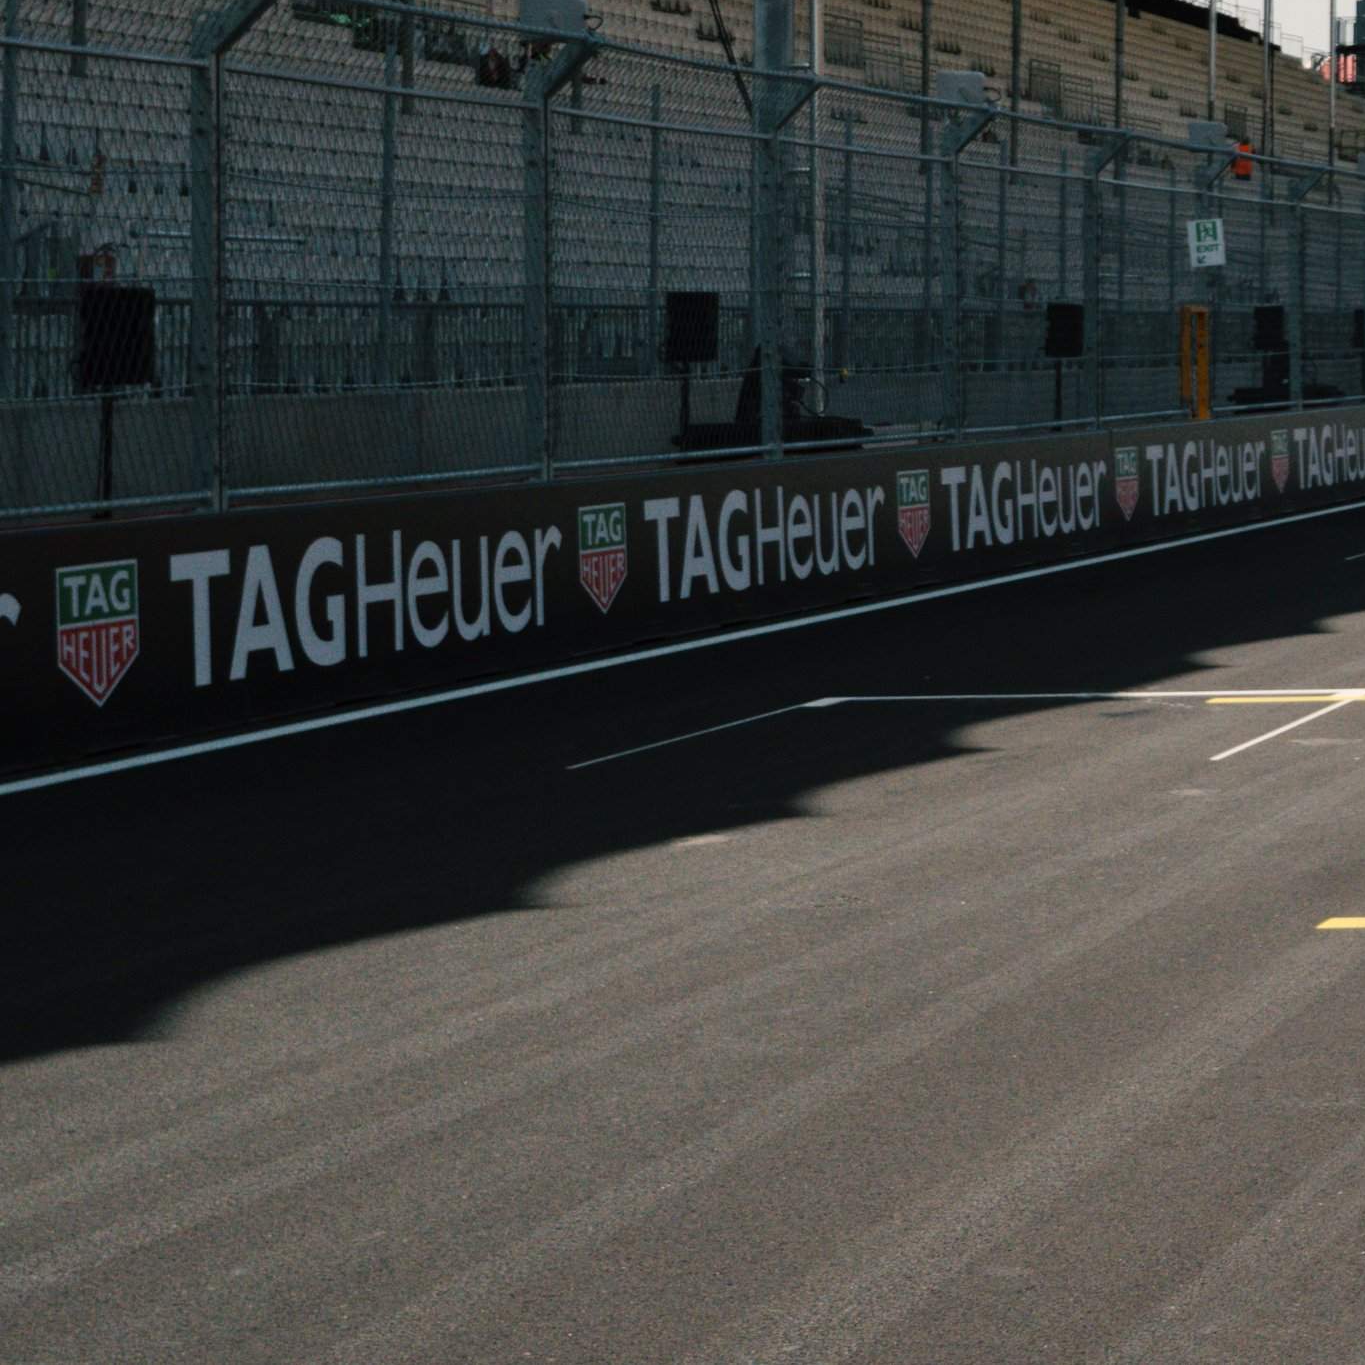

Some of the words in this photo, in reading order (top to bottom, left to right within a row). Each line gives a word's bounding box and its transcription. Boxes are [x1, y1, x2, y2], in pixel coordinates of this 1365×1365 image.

[900, 476, 928, 503] TAG
[941, 459, 1107, 551] TAGHeuer
[1145, 438, 1265, 516] TAGHeuer
[583, 511, 622, 546] TAG
[644, 485, 885, 602] TAGHeuer
[62, 570, 131, 618] TAG
[170, 524, 562, 688] TAGHeuer
[63, 624, 136, 694] HEUER
